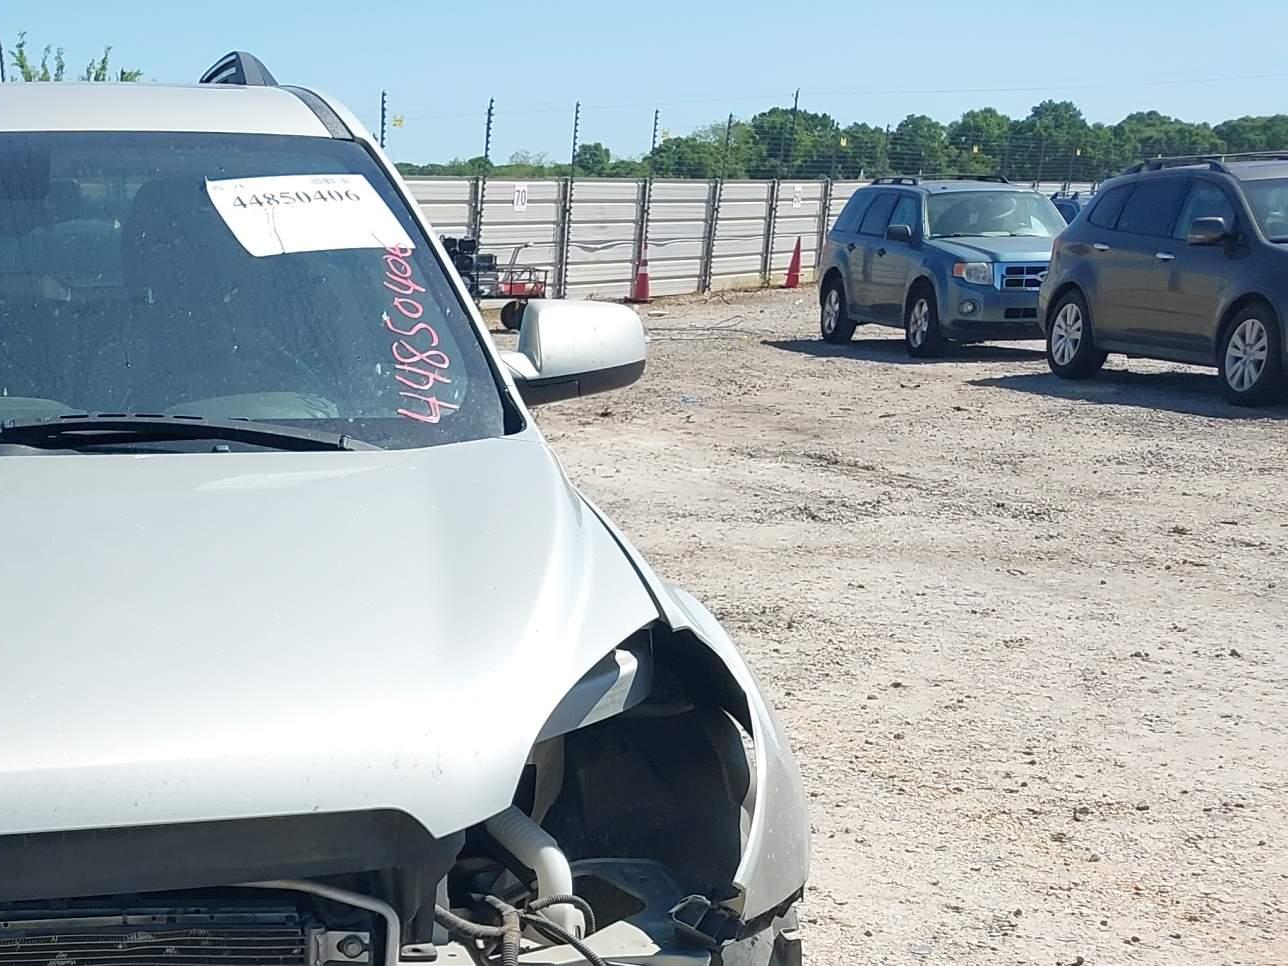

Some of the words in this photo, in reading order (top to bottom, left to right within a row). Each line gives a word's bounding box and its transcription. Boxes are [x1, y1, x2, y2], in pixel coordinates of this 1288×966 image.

[232, 187, 361, 209] 44850406
[515, 189, 527, 206] 70
[383, 242, 460, 424] 44850406
